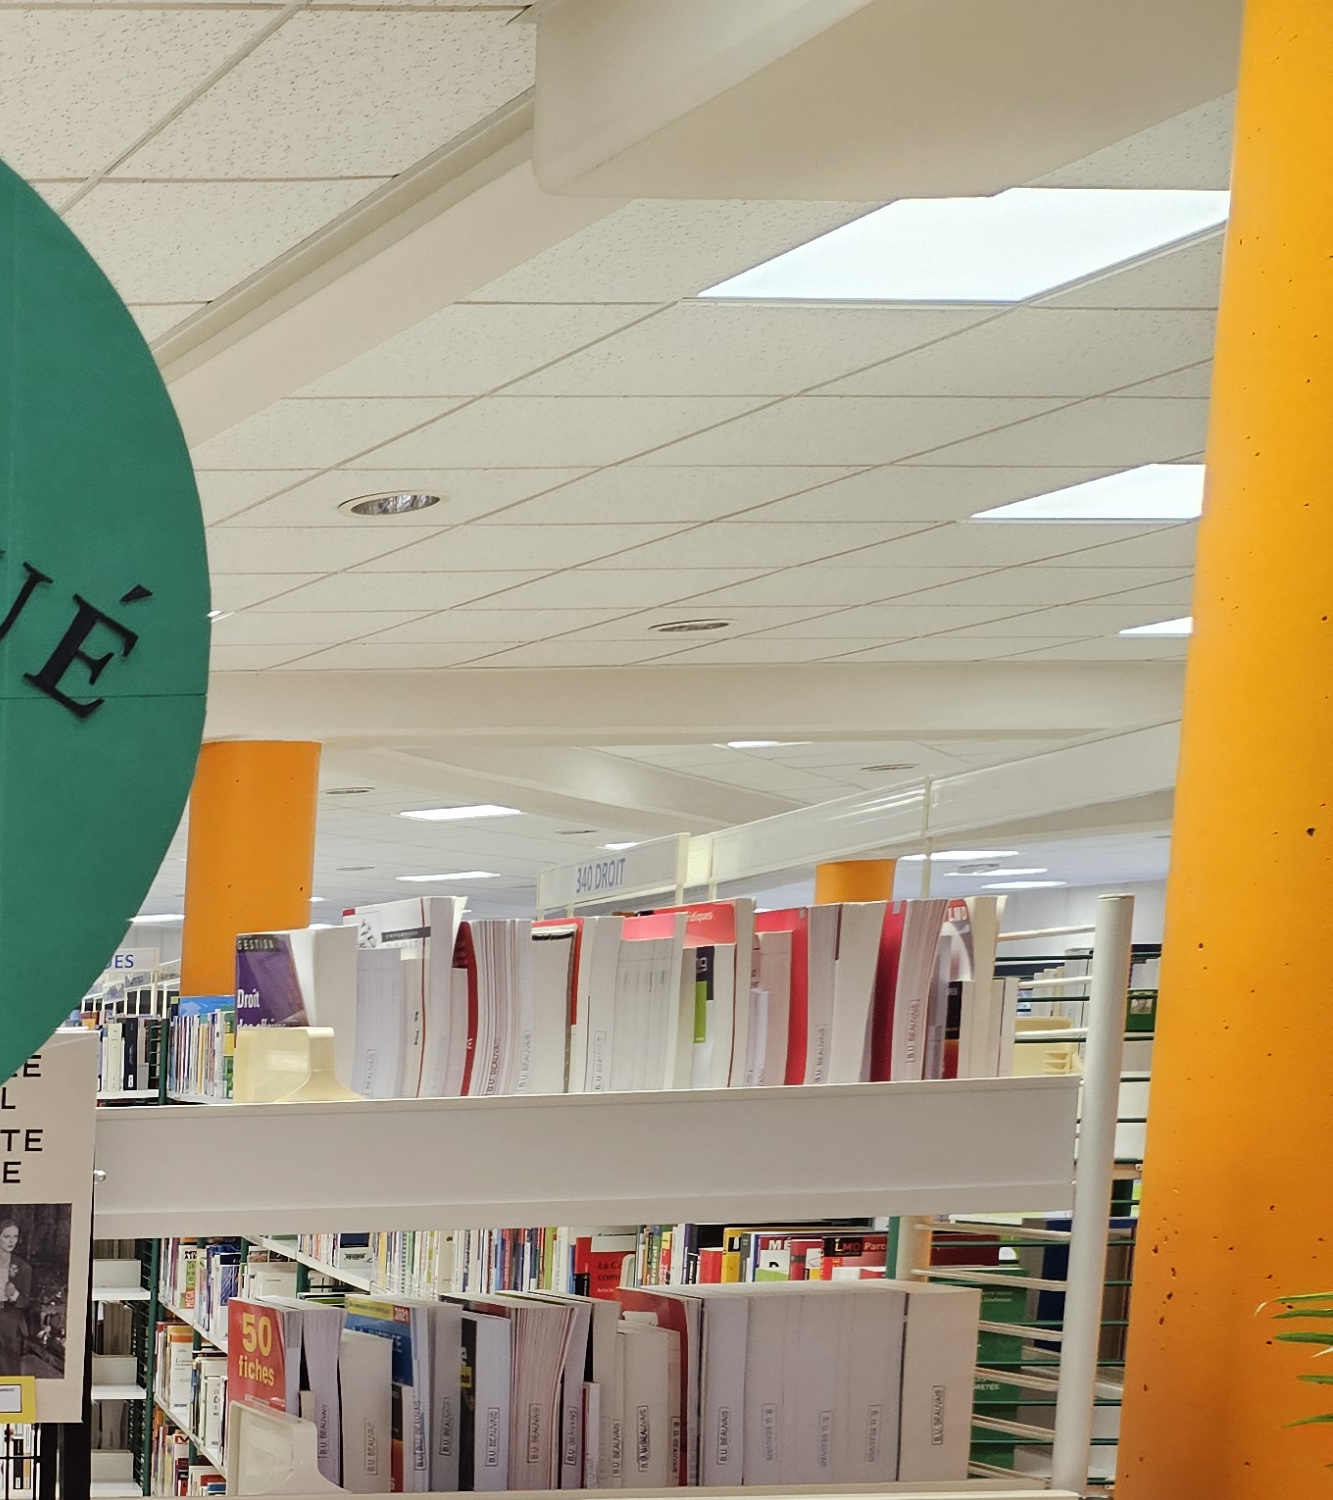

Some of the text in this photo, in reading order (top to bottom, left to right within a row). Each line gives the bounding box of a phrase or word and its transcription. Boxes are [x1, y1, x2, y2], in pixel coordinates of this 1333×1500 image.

[576, 857, 626, 893] 340 DROIT
[241, 1314, 273, 1358] 50
[237, 1354, 275, 1387] fiches
